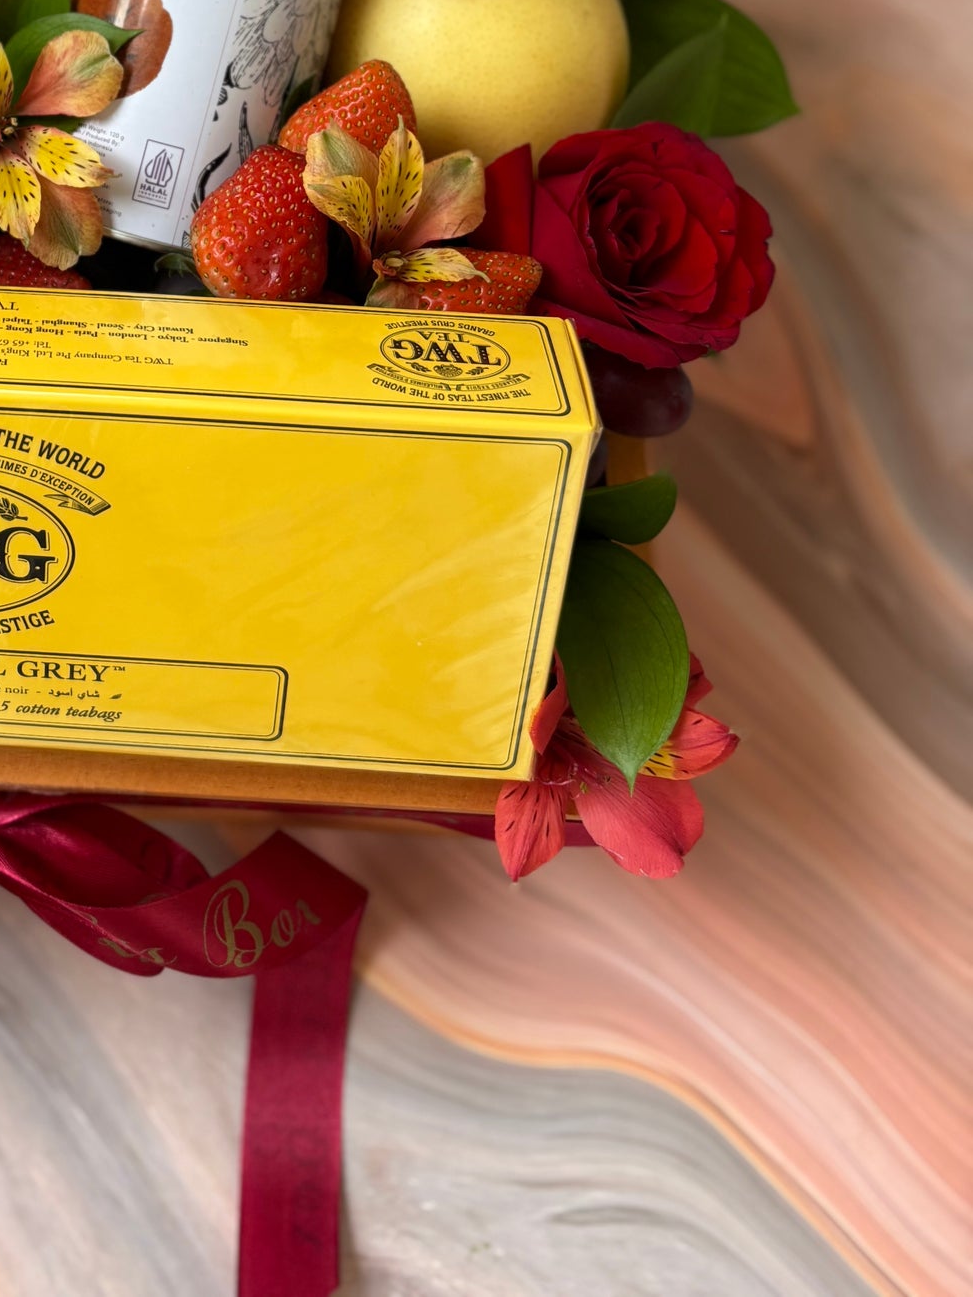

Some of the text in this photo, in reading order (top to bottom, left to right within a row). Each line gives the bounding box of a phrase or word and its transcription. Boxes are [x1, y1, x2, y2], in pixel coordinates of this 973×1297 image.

[140, 184, 167, 196] HALAL
[2, 316, 32, 326] Taipei
[41, 318, 87, 329] Shanghai
[97, 322, 125, 330] Seoul
[385, 320, 428, 330] PRESTIGE
[5, 324, 33, 334] Kong
[36, 326, 64, 336] Hong
[134, 323, 155, 332] City
[157, 326, 194, 334] Kuwait
[458, 323, 495, 337] GRANDS
[74, 329, 97, 338] Paris
[109, 331, 147, 340] London
[157, 334, 188, 343] Tokyo
[418, 330, 470, 343] TEA
[12, 339, 30, 347] +65
[198, 336, 248, 346] Singapore
[55, 351, 71, 359] Pte
[75, 351, 121, 362] Company
[389, 339, 501, 366] TWG
[125, 355, 142, 364] Tea
[145, 357, 173, 366] TWG
[372, 377, 406, 394] WORLD
[410, 389, 429, 398] THE
[433, 393, 445, 401] OF
[477, 392, 510, 401] FINEST
[512, 388, 531, 398] THE
[38, 442, 106, 480] WORLD
[5, 686, 30, 694] noir
[16, 703, 61, 716] cotton
[66, 706, 123, 722] teabags
